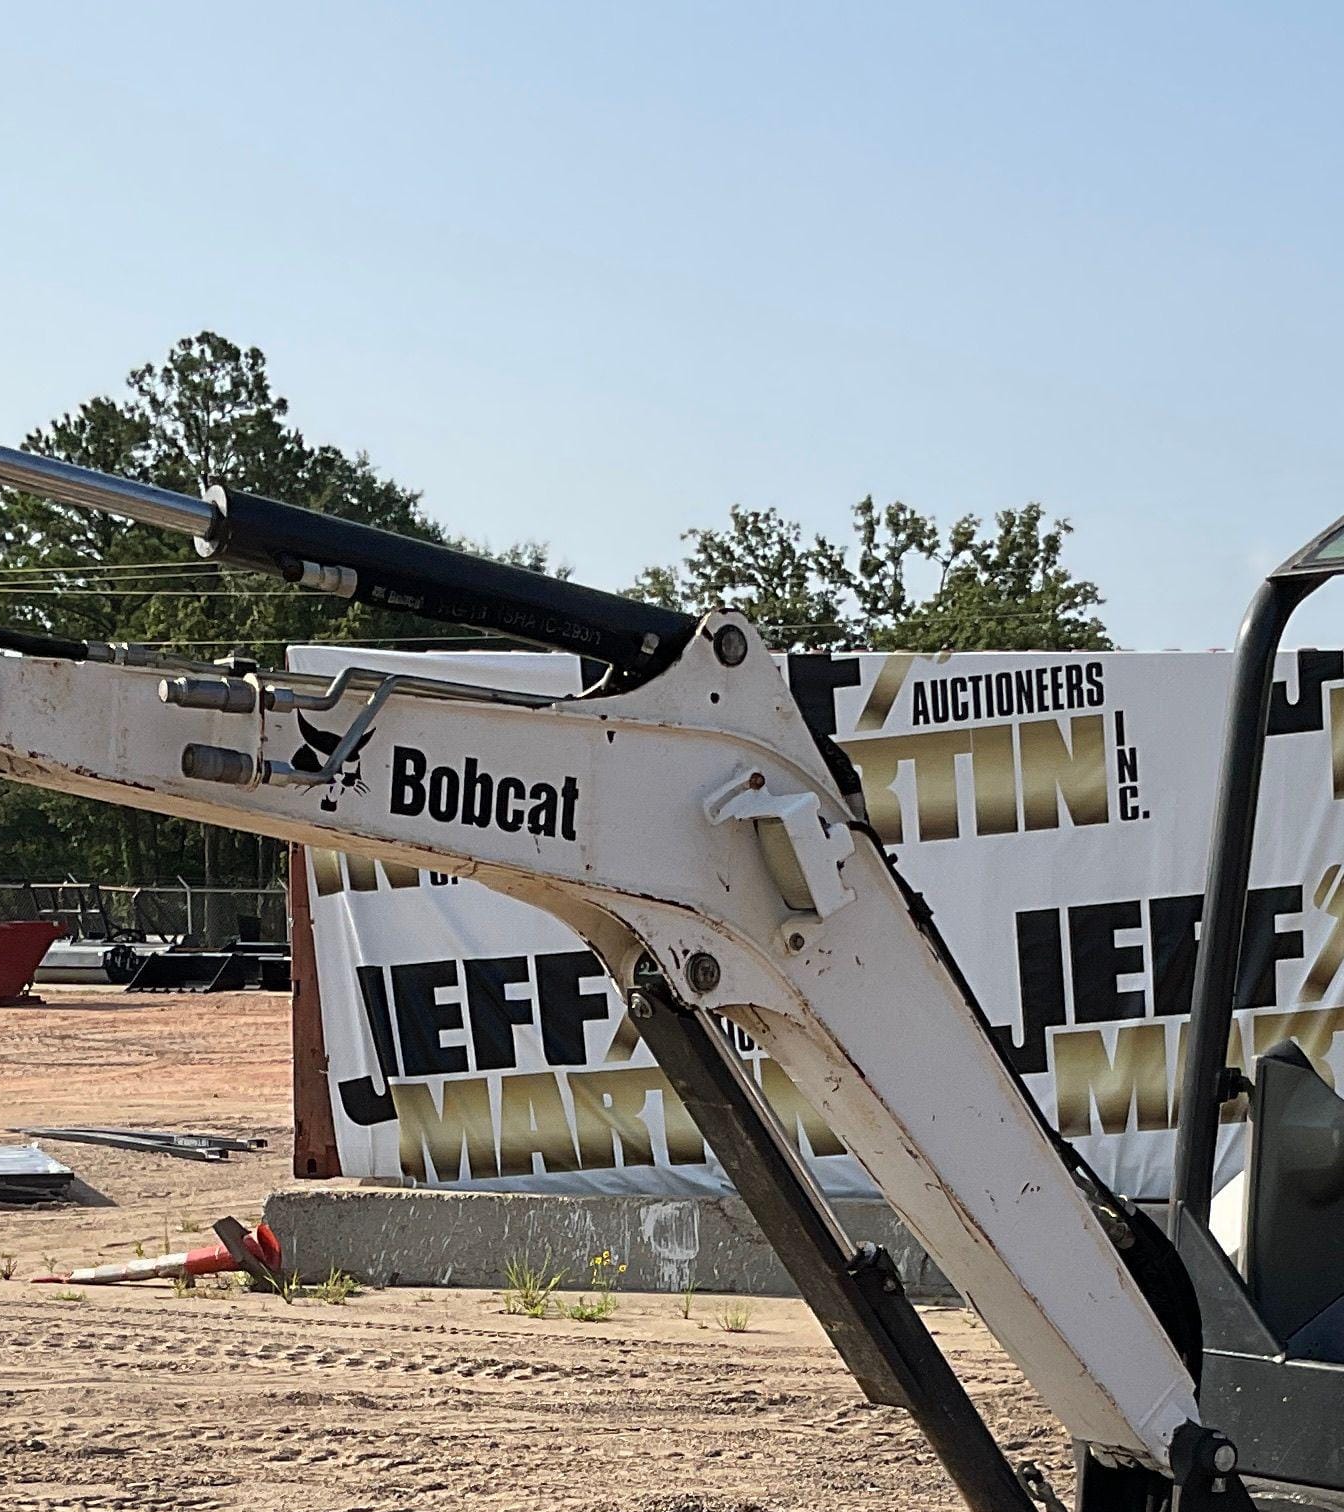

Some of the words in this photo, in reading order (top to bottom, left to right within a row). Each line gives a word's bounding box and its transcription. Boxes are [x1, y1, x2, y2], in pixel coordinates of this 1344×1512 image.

[912, 661, 1105, 726] AUCTIONEERS
[388, 743, 581, 842] Bobcat
[836, 713, 1110, 845] RTIN
[338, 949, 609, 1127] JEFF
